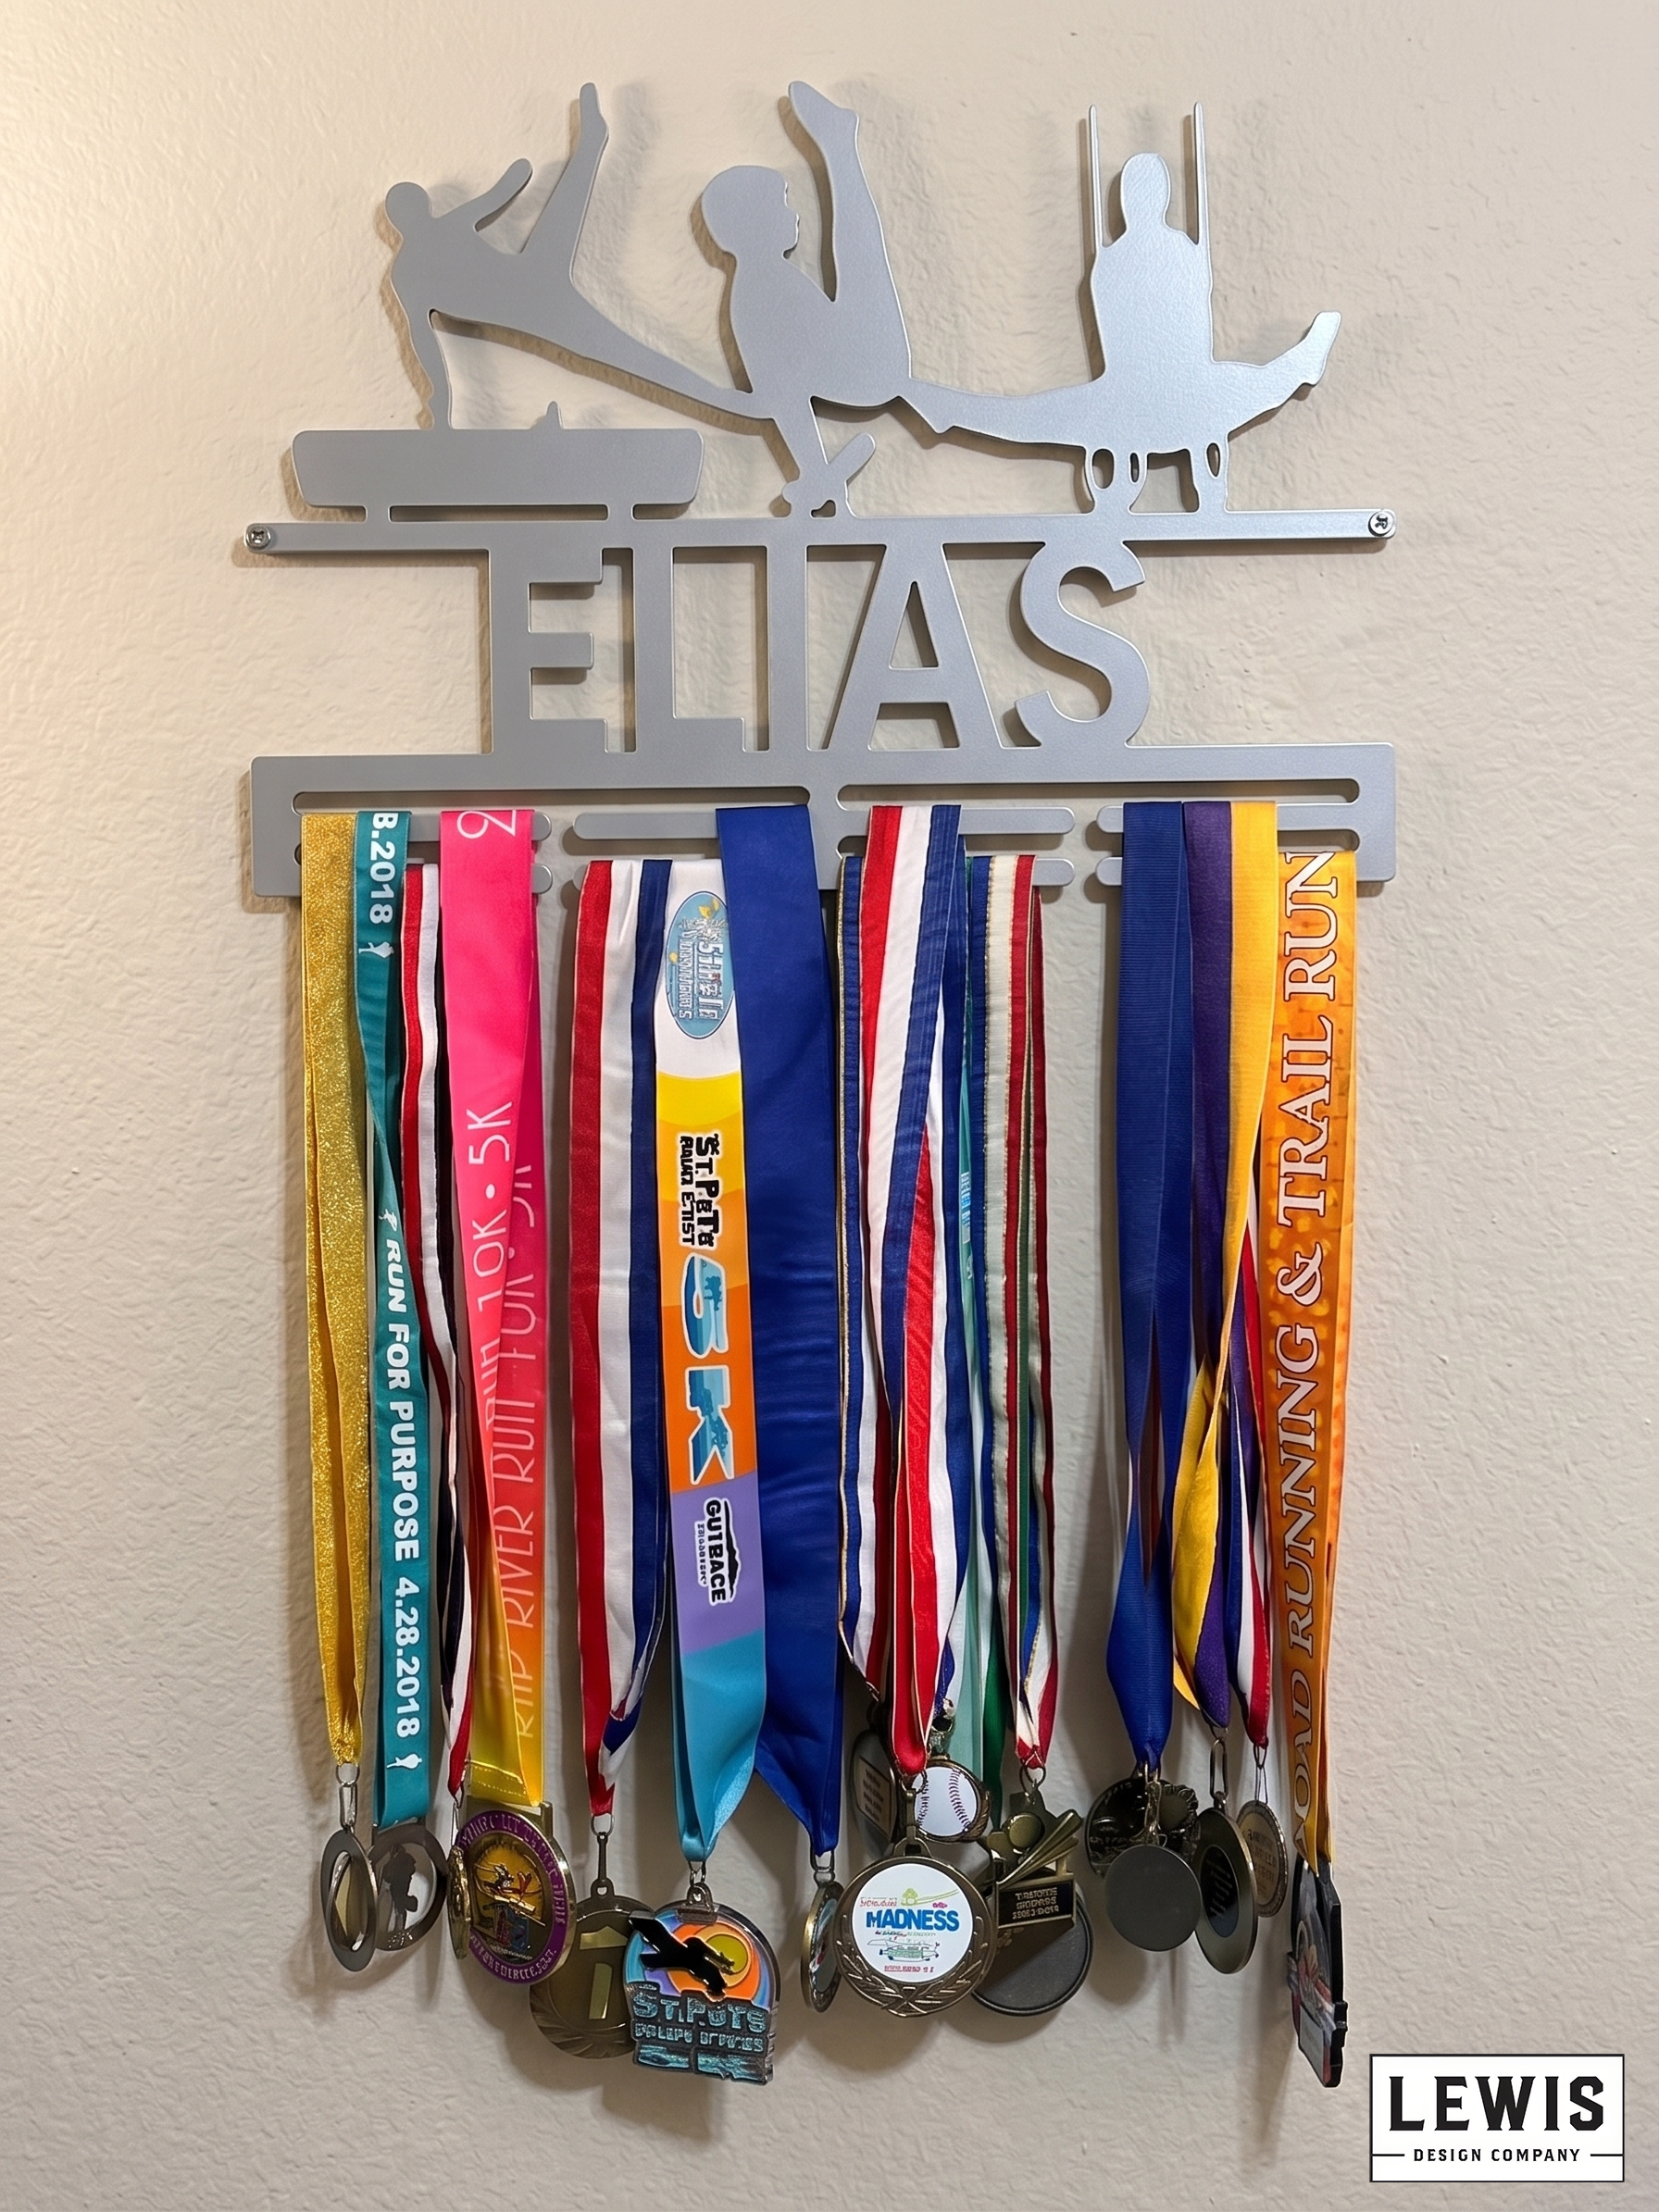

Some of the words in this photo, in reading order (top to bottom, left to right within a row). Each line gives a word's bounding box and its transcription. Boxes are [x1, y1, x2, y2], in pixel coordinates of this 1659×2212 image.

[489, 529, 1151, 752] ELIAS
[1283, 851, 1339, 1001] RUN
[466, 1100, 513, 1165] 5K
[1278, 1014, 1333, 1227] TRAIL
[386, 1238, 407, 1313] RUN
[1276, 1242, 1323, 1307] &
[386, 1323, 411, 1390] FOR
[390, 1400, 419, 1561] PURPOSE
[1275, 1324, 1320, 1658] RUNNING
[394, 1576, 421, 1738] 4.28.2018
[866, 1908, 960, 1932] MADNESS
